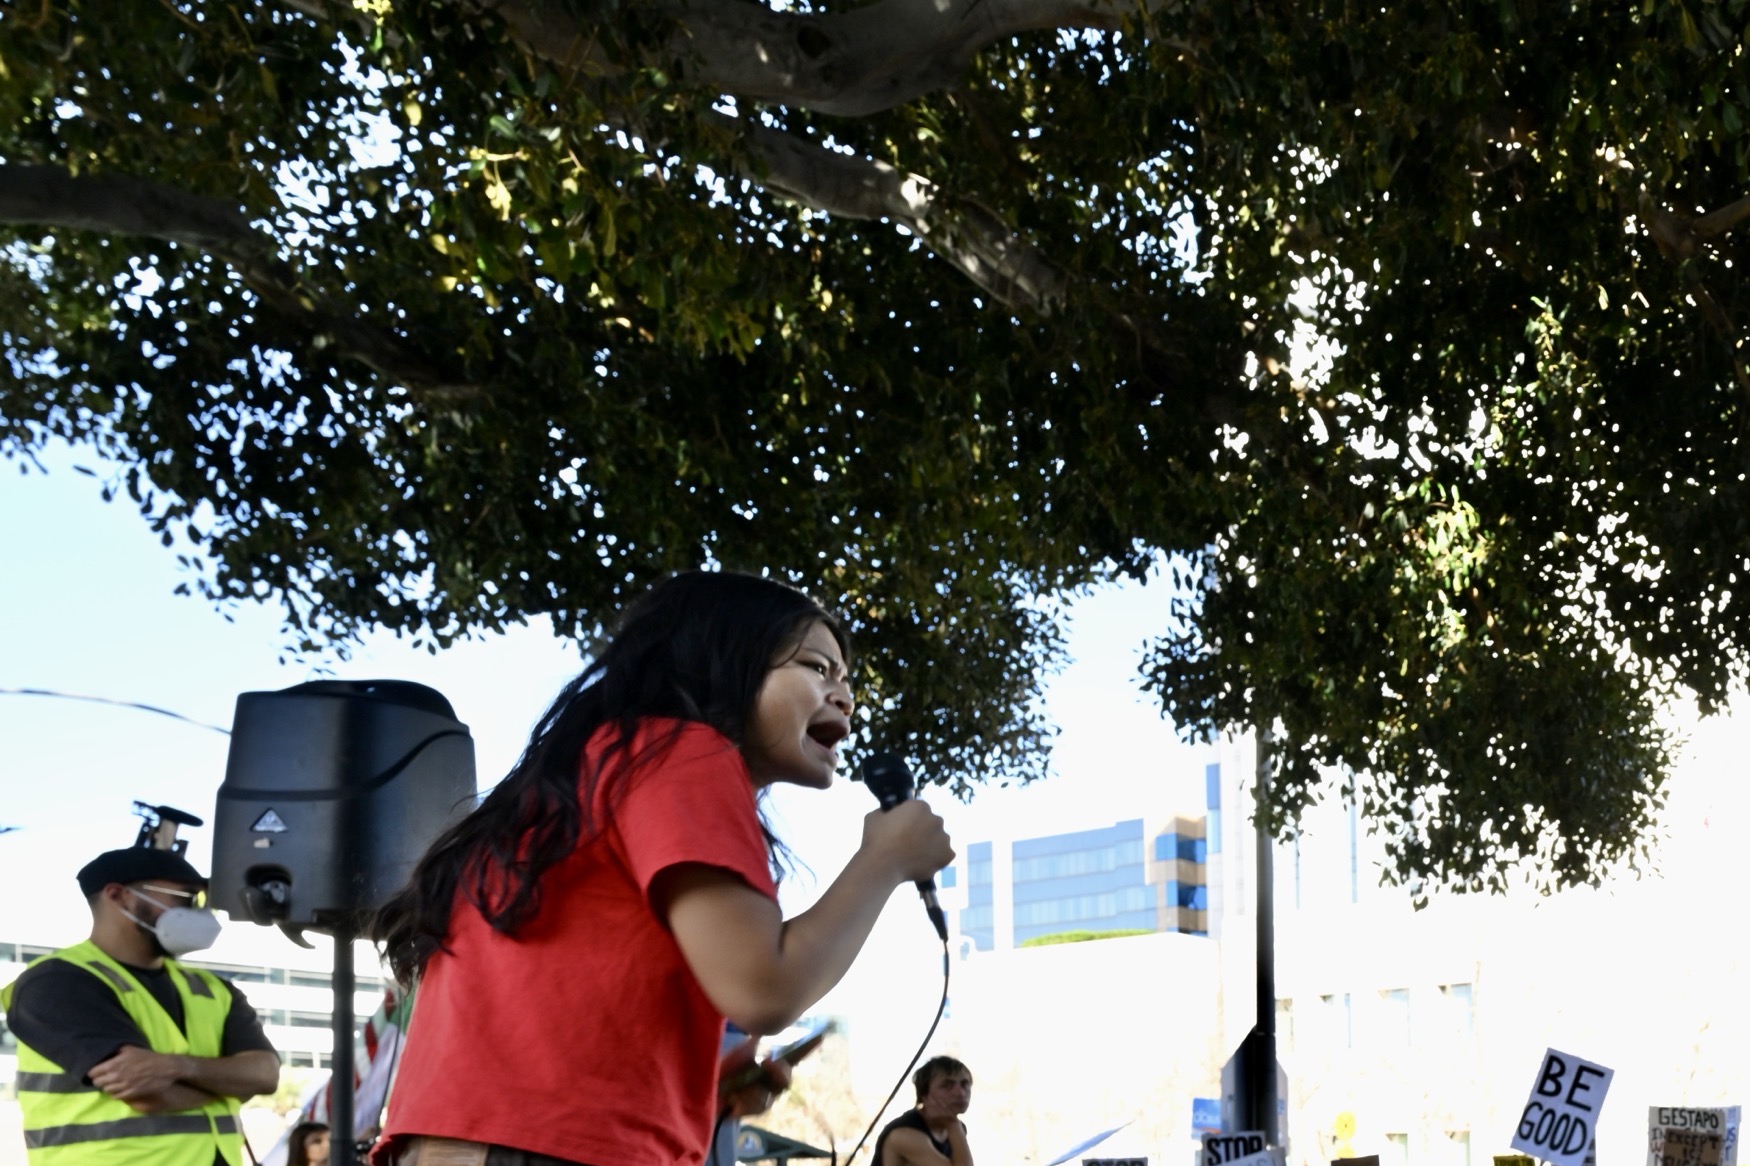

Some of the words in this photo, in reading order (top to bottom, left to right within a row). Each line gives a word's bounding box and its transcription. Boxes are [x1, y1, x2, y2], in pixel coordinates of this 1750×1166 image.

[1537, 1055, 1605, 1112] BE
[1518, 1101, 1588, 1157] GOOD
[1658, 1107, 1719, 1128] GESTAPO
